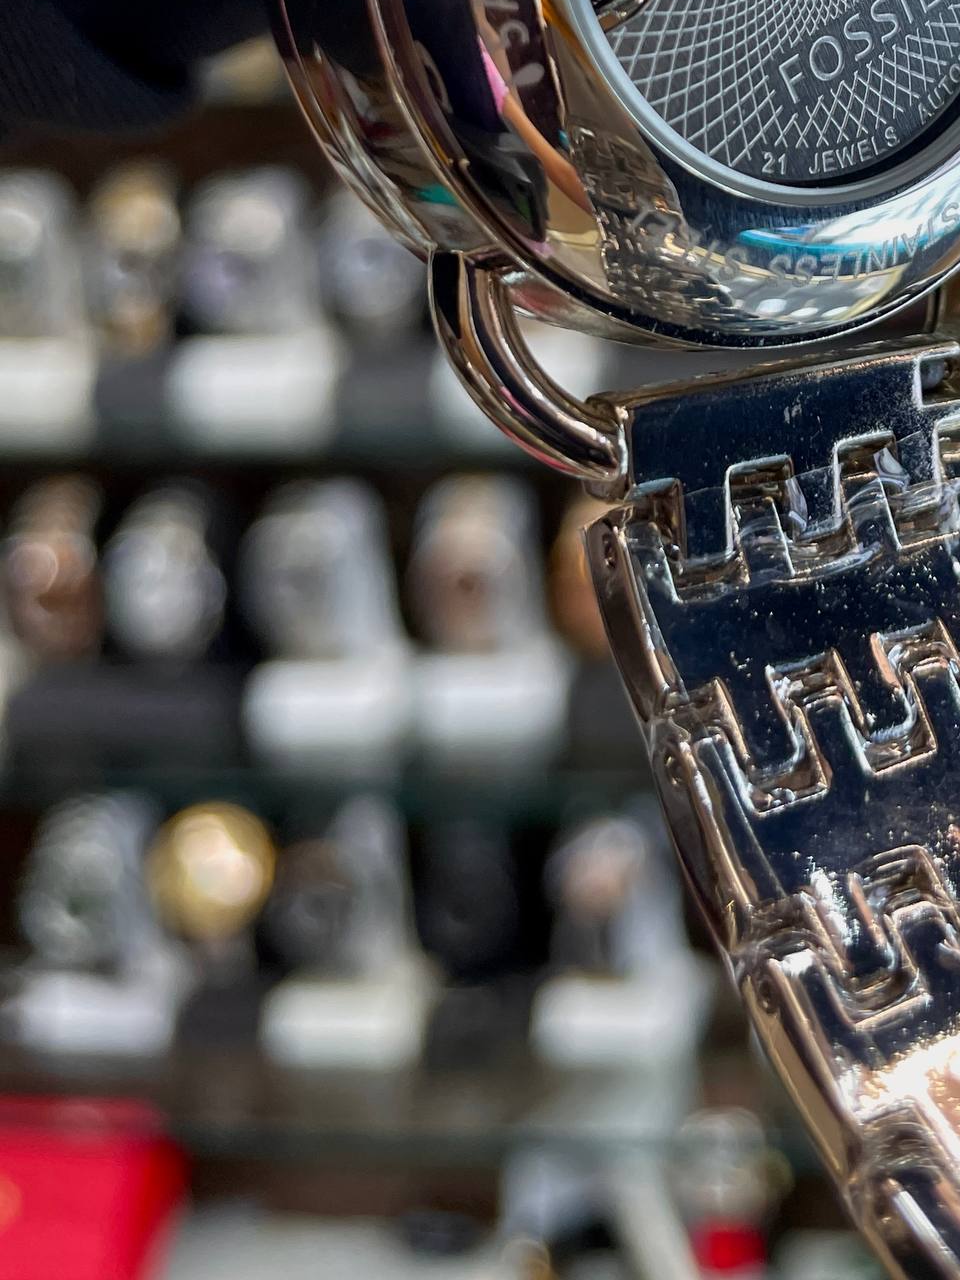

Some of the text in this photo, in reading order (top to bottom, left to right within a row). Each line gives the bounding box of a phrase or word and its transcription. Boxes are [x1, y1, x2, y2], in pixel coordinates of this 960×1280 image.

[761, 151, 787, 175] 21
[807, 125, 900, 175] JEWELS
[768, 201, 960, 288] STAINLESS
